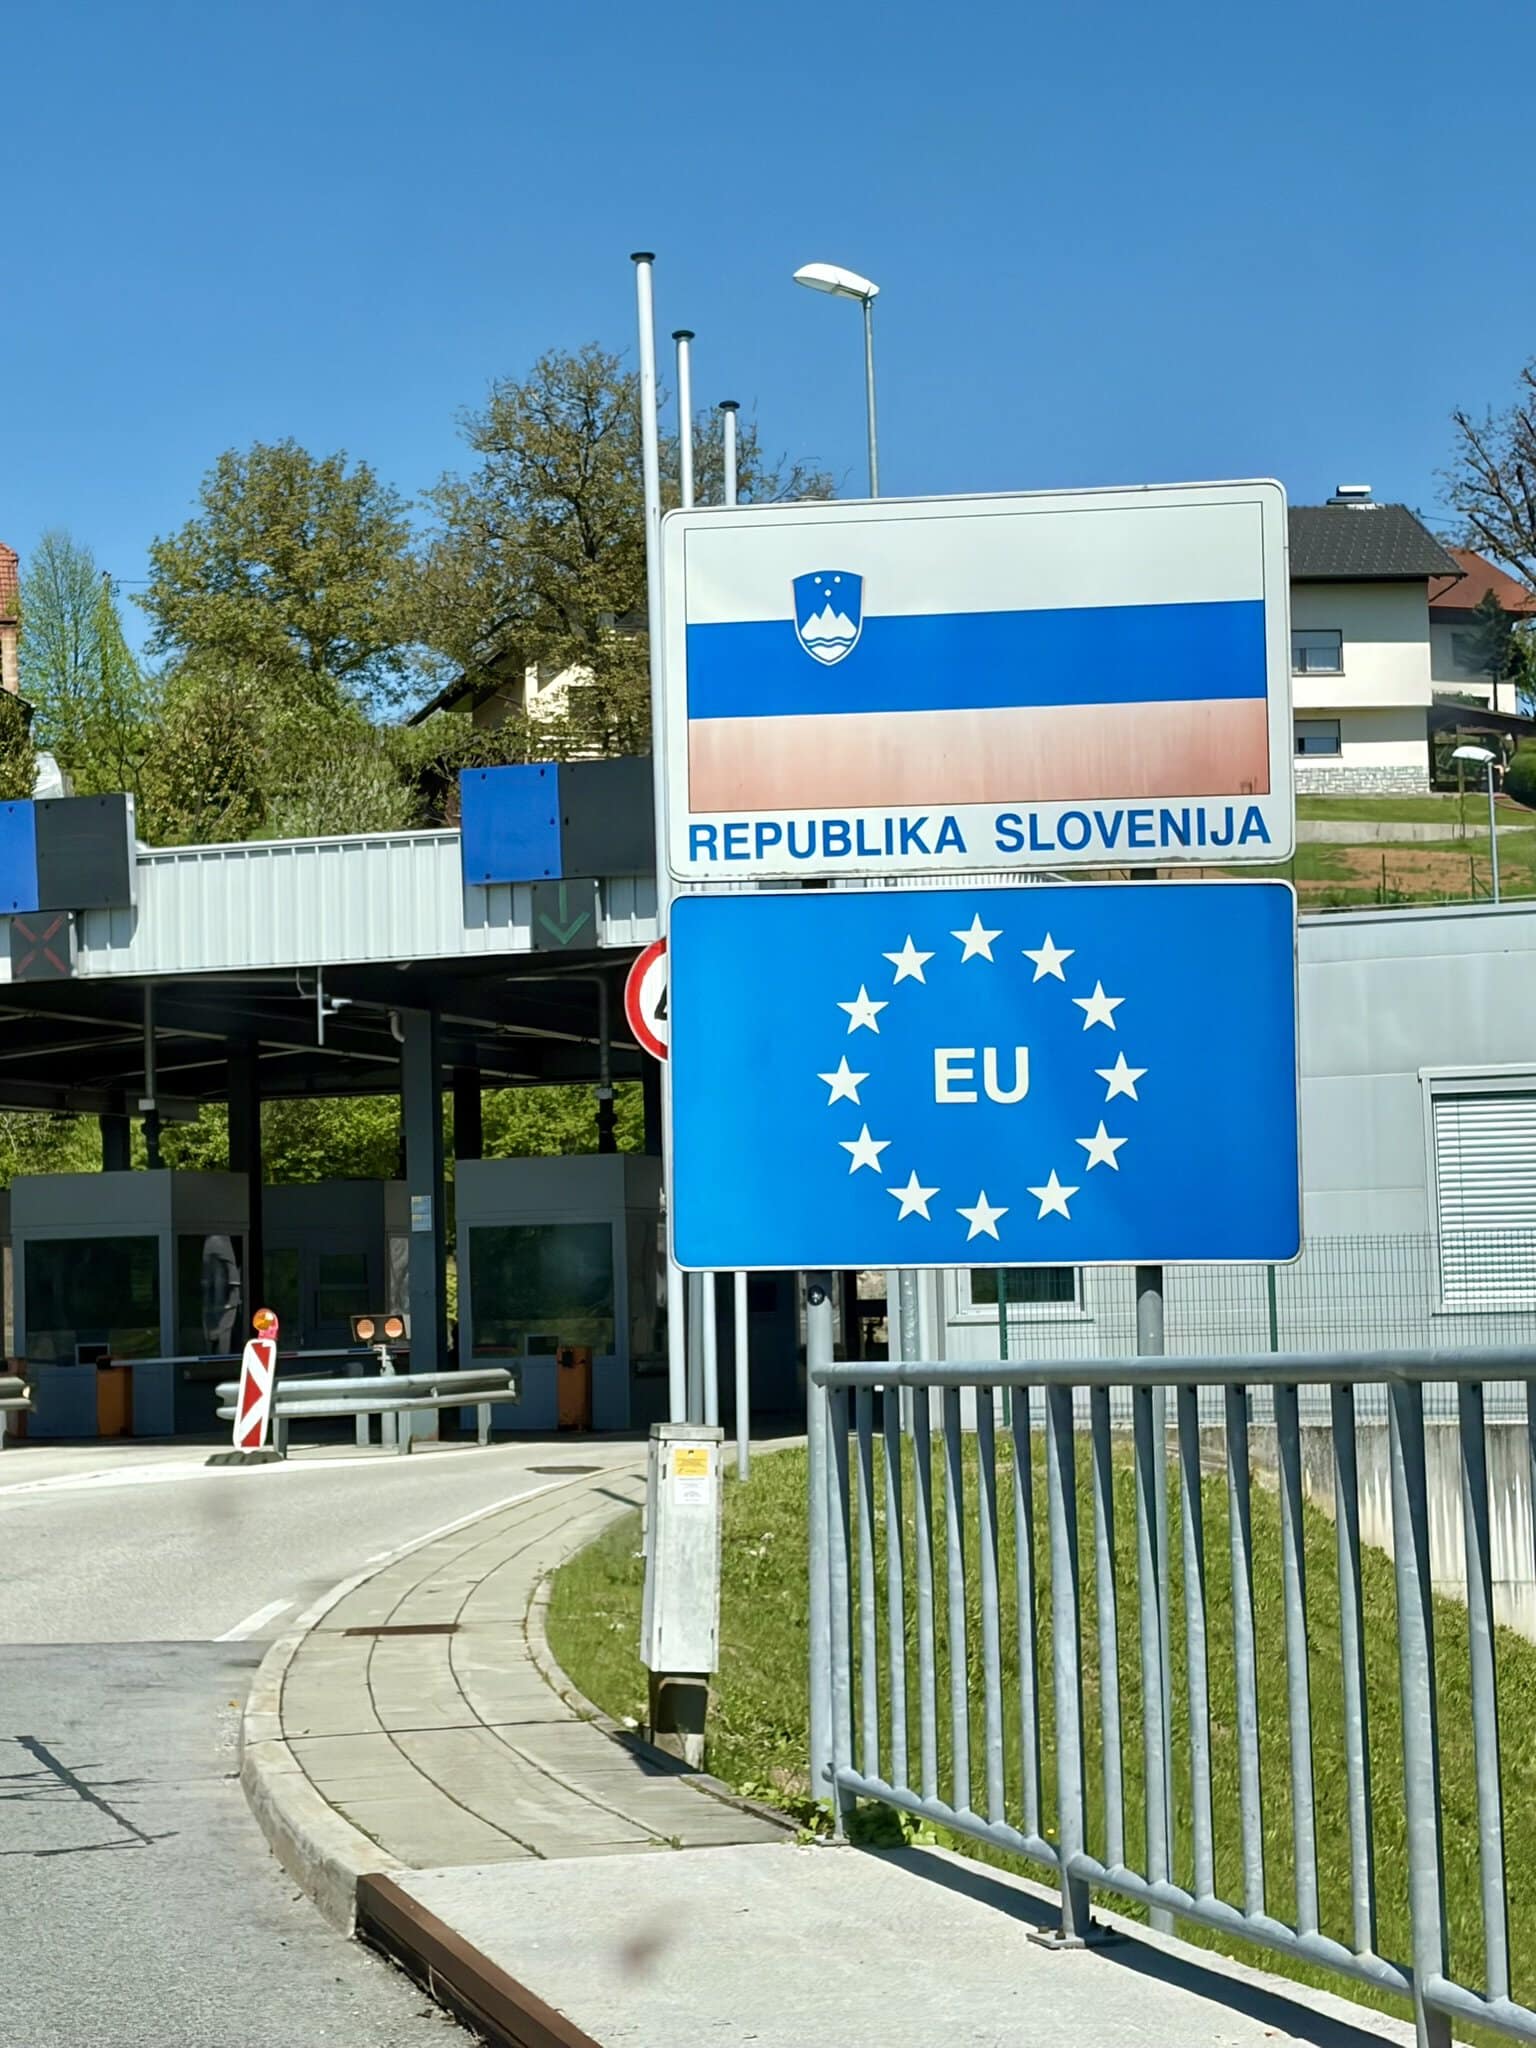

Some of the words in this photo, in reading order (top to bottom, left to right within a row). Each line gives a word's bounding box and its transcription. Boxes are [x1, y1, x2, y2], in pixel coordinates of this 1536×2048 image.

[689, 816, 967, 861] REPUBLIKA
[995, 806, 1271, 853] SLOVENIJA
[934, 1046, 1029, 1104] EU
